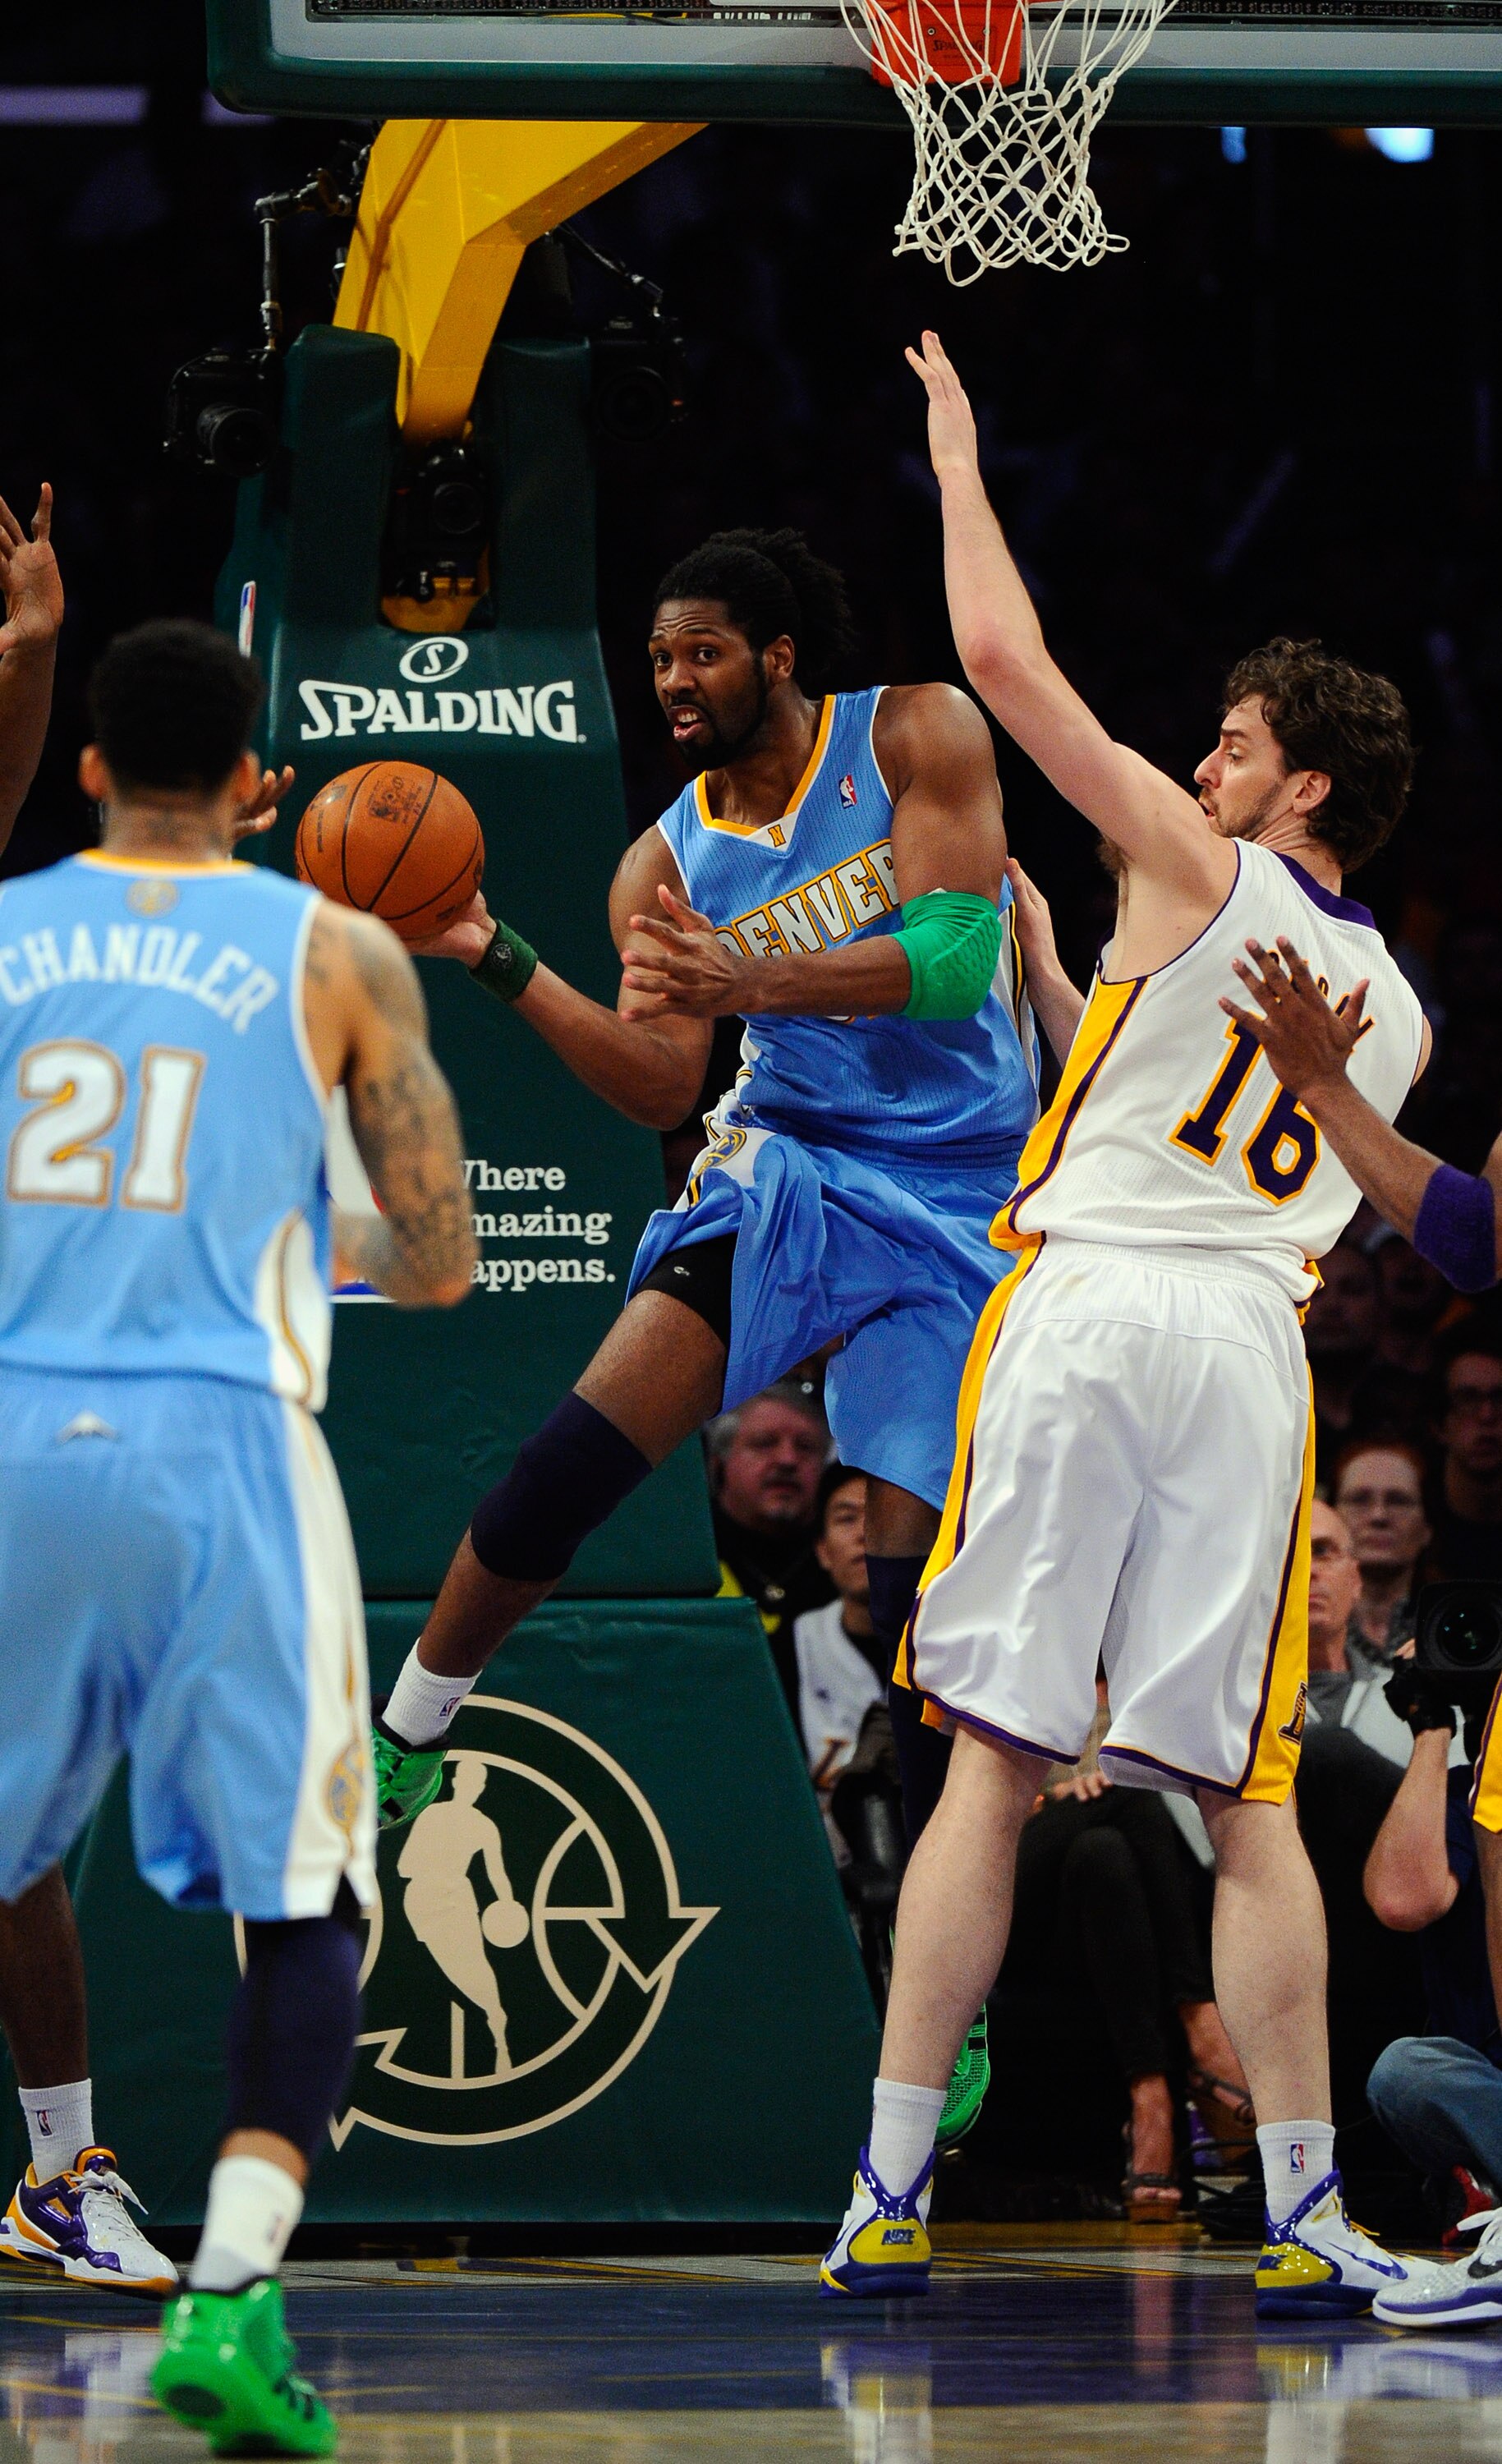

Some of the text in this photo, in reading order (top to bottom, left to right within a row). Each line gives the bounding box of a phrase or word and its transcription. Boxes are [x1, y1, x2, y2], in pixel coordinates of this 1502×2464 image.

[299, 680, 578, 743] SPALDING
[768, 824, 787, 848] N
[0, 922, 279, 1035] CHANDLER
[7, 1037, 207, 1215] 21
[1169, 1011, 1321, 1207] 16
[471, 1205, 613, 1245] mazing
[470, 1259, 616, 1292] appens.
